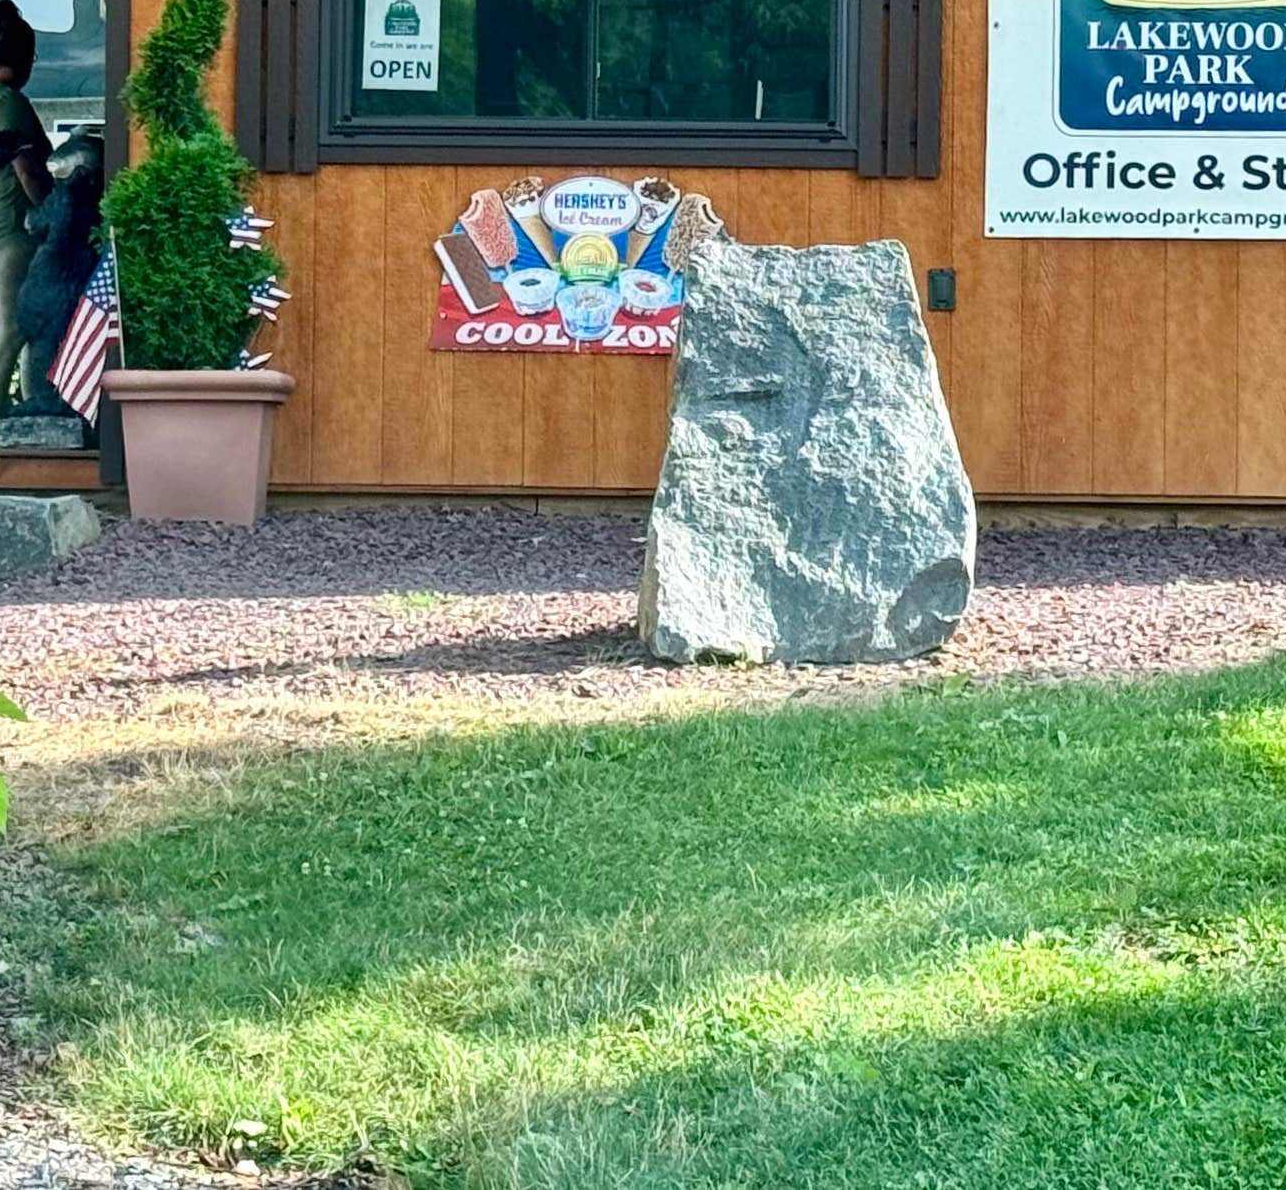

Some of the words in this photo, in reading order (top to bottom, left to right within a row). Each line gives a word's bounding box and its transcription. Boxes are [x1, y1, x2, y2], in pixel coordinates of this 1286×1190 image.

[369, 59, 432, 79] OPEN
[1142, 54, 1254, 85] PARK
[1022, 151, 1176, 190] Office
[1192, 154, 1225, 190] &
[554, 193, 628, 210] HERSHEY'S
[558, 210, 575, 225] Ice
[579, 211, 622, 226] Cream
[455, 321, 570, 346] COOL
[602, 321, 679, 348] ZON
